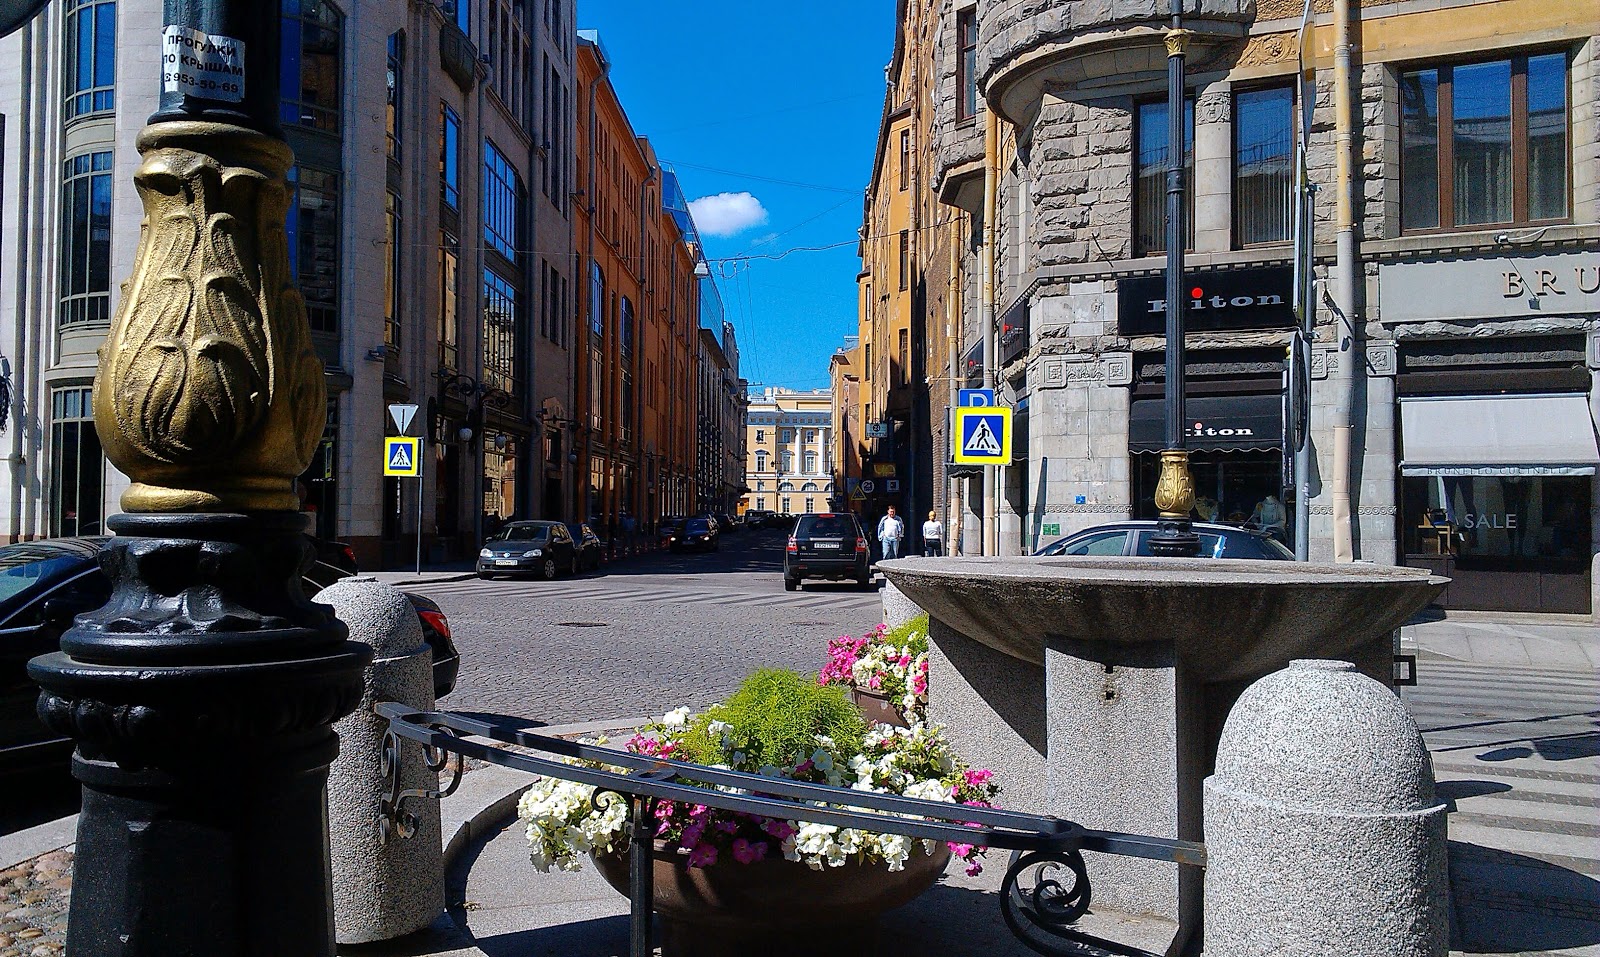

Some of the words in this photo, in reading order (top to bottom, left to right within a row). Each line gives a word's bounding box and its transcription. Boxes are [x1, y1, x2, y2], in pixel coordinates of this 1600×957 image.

[168, 34, 236, 58] ПРОГУЛКИ
[180, 54, 243, 76] КРЫШАМ
[1502, 266, 1600, 298] BRU
[1185, 422, 1253, 436] iton
[1464, 513, 1517, 529] SALE
